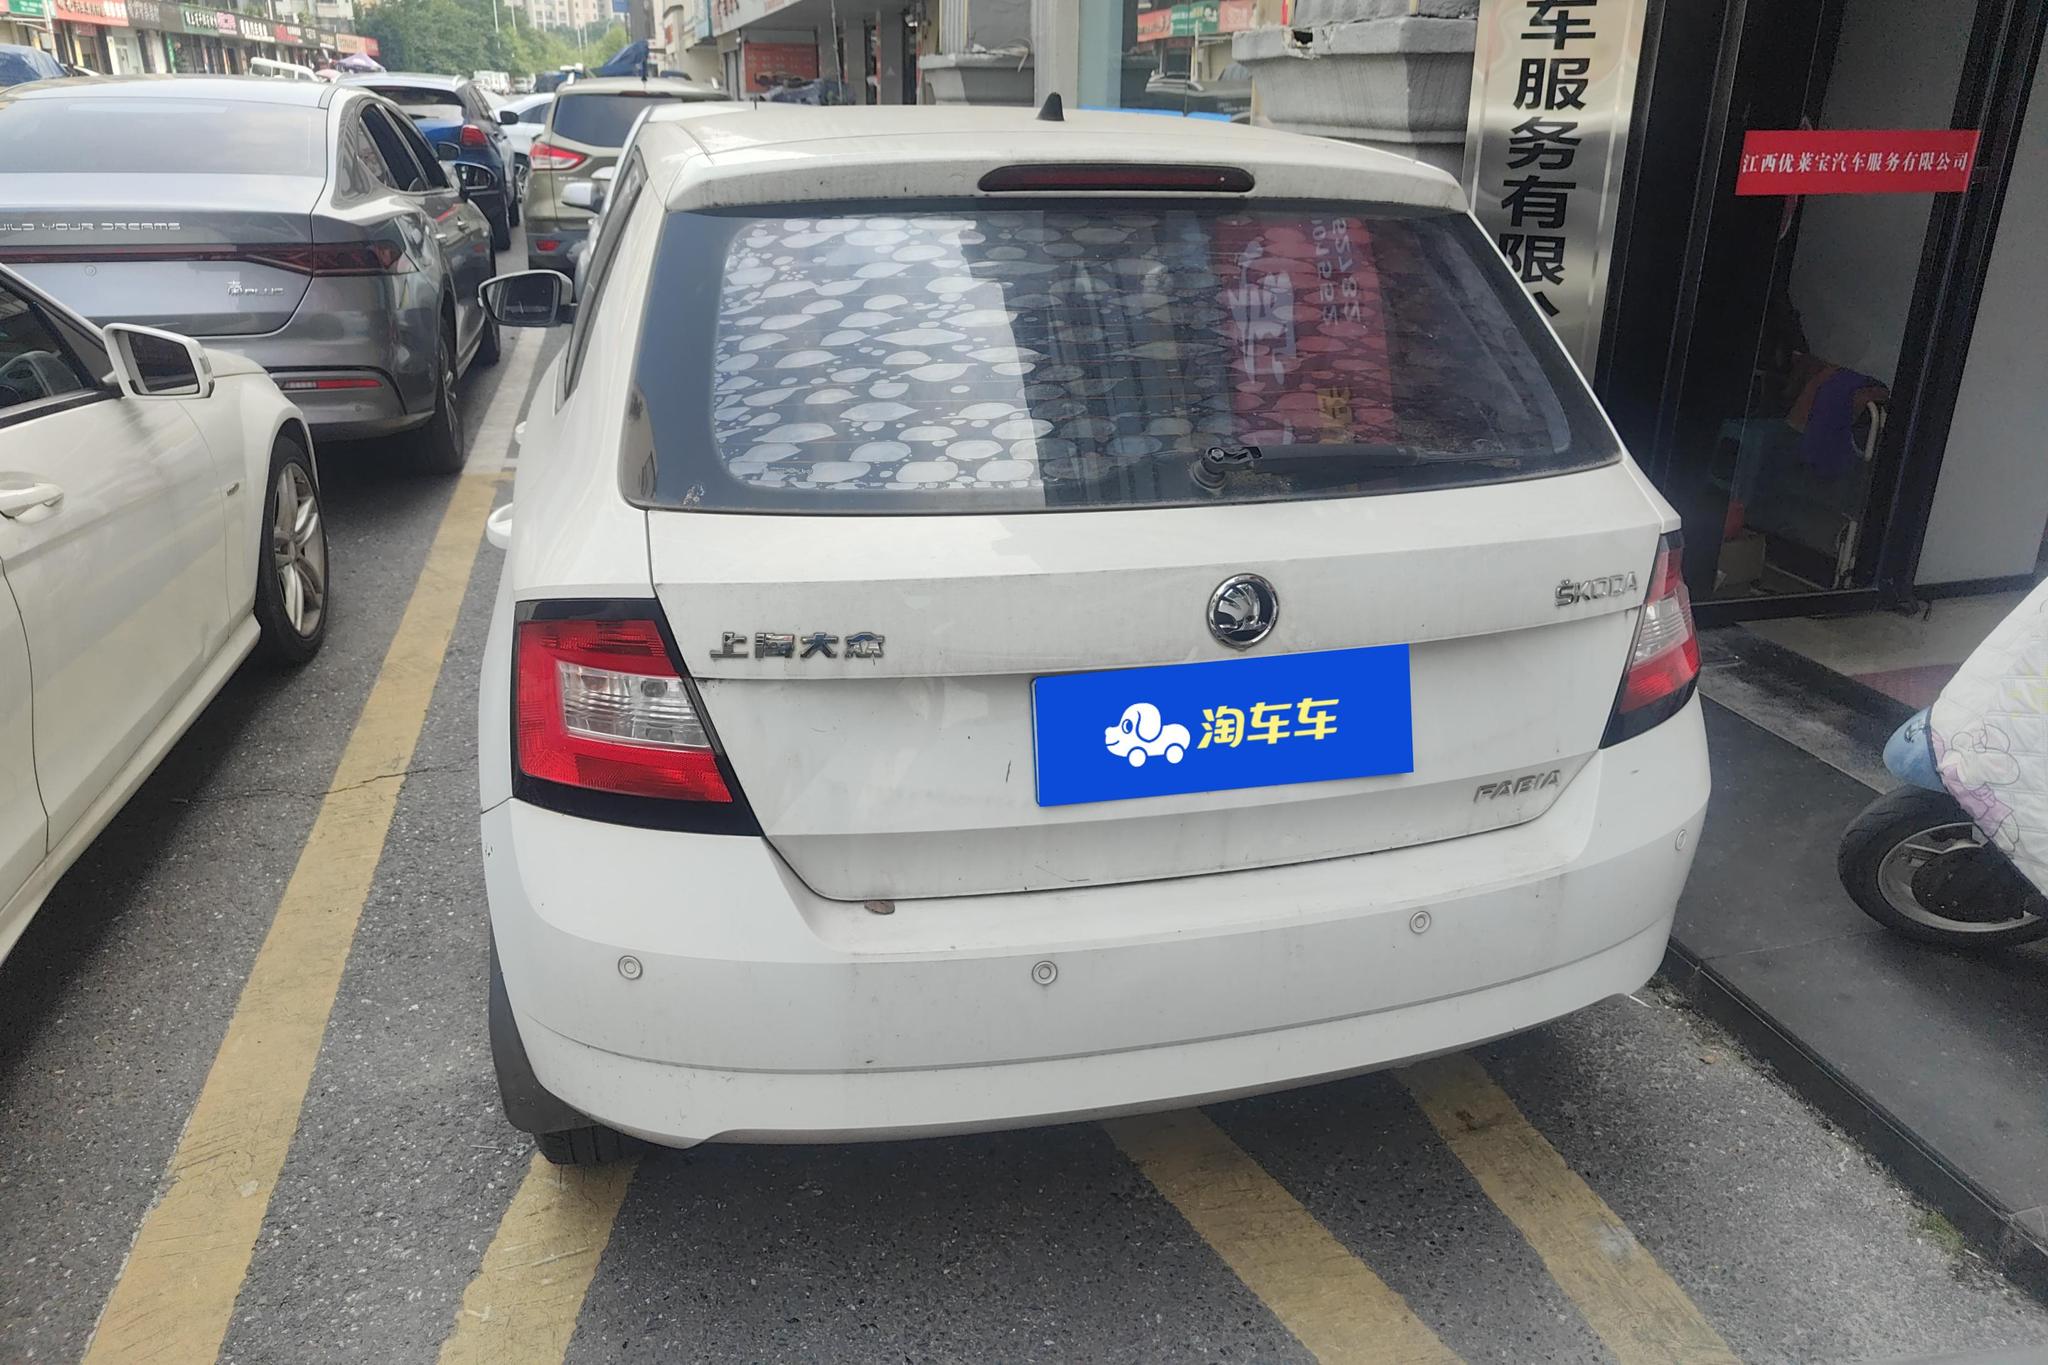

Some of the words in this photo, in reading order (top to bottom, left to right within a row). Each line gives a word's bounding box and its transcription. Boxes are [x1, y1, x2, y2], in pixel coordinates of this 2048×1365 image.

[1498, 0, 1598, 317] 车服务有限
[1742, 150, 1969, 174] 江西优莱宝汽车服务有限公司
[41, 222, 95, 231] YOUR
[101, 222, 181, 231] DREAMS
[709, 631, 885, 659] 上海大众
[1473, 769, 1561, 804] FABIA
